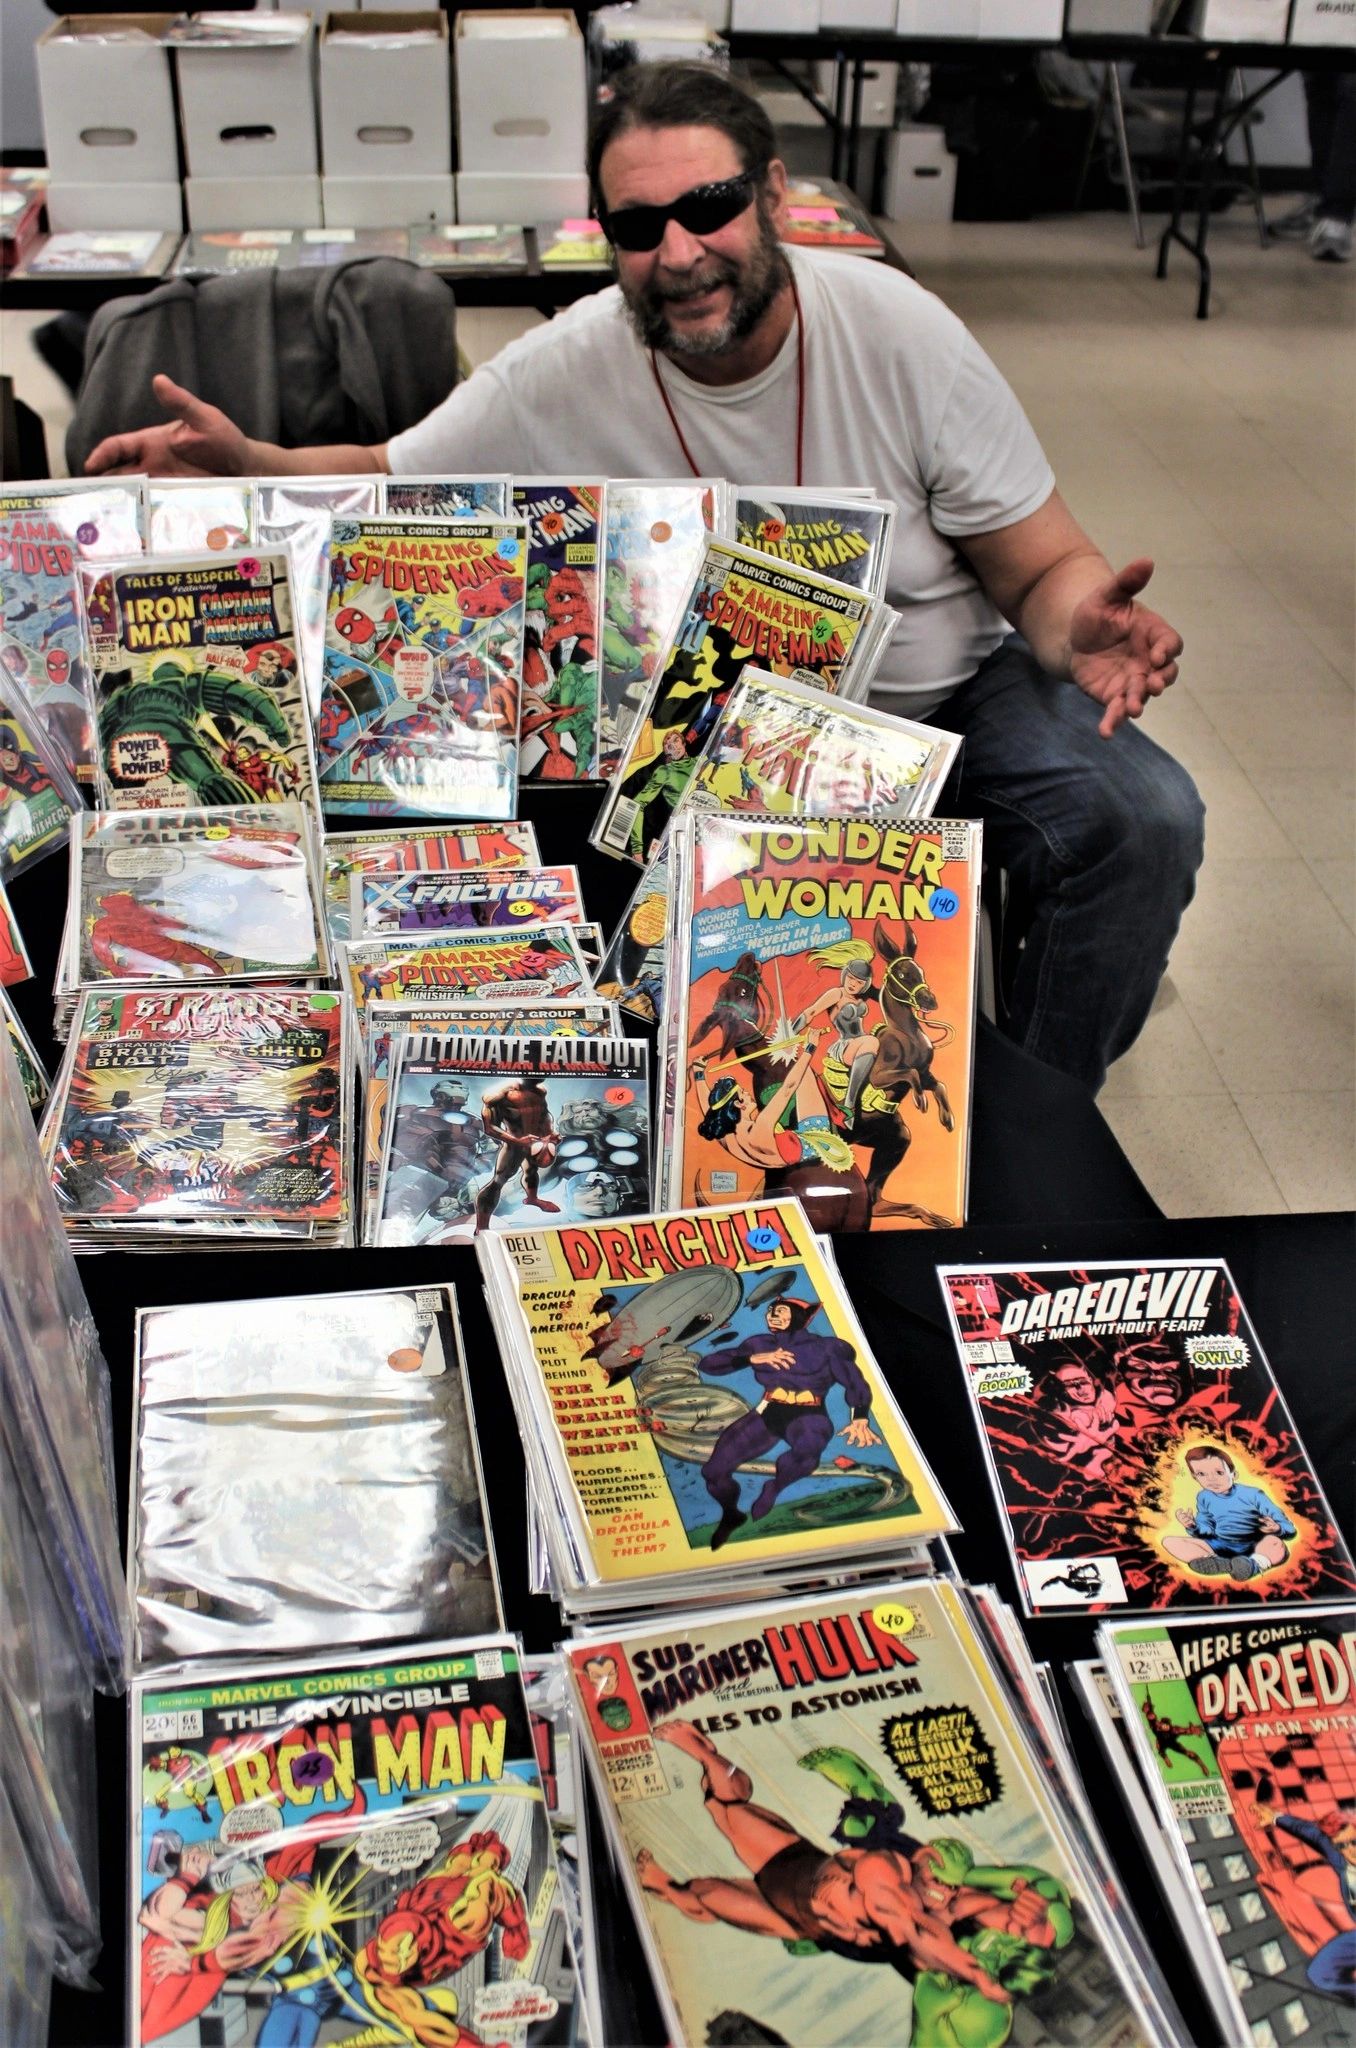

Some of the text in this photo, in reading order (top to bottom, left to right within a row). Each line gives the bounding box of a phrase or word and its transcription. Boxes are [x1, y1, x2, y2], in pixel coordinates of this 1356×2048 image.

[364, 526, 489, 536] MARVEL COMICS GROUP
[766, 525, 781, 535] 40
[386, 540, 483, 561] AMAZING
[502, 544, 515, 554] 20
[740, 530, 871, 569] PIDER-MAN
[125, 569, 248, 588] TALES OF SUSPENS
[346, 551, 516, 594] SPIDER-MAN
[733, 560, 849, 611] MARVEL COMICS GROUP
[124, 595, 196, 624] IRON
[743, 588, 825, 630] AMAZING
[128, 621, 192, 649] MAN
[704, 590, 847, 667] SPIDER-MAN
[119, 739, 161, 753] POWER
[121, 760, 165, 775] POWER!
[356, 828, 497, 844] MARVEL COMICS GROUP
[364, 874, 561, 911] X-FACTOR
[740, 877, 936, 921] WOMAN
[931, 896, 955, 913] 140
[698, 908, 739, 926] WONDER
[698, 919, 737, 934] WOMAN
[794, 926, 809, 938] IN
[811, 923, 821, 935] A
[389, 932, 545, 950] MAREL COMICS GROUP
[760, 940, 808, 958] MILLION
[420, 944, 531, 966] AMAZING
[380, 948, 575, 987] PIDER-MN
[411, 1010, 577, 1020] MARVEL COMICS GROUP
[99, 1047, 175, 1057] BRAIN
[403, 1036, 646, 1068] ULTIMATE FALLOUT
[506, 1236, 541, 1252] DELL
[557, 1207, 802, 1282] DRACULA
[753, 1233, 771, 1245] 10
[522, 1289, 576, 1301] DRACULA
[1001, 1269, 1217, 1335] DAREDEVIL
[532, 1299, 573, 1312] COMES
[549, 1313, 563, 1322] TO
[530, 1321, 590, 1334] AMERICA!
[1020, 1319, 1206, 1345] THE MAN WITHOUT FEAR!
[537, 1346, 558, 1356] THE
[1193, 1350, 1243, 1365] OWL!
[541, 1357, 567, 1368] PLOT
[544, 1369, 587, 1380] BEHIND
[985, 1371, 1013, 1379] BABY
[550, 1384, 593, 1396] THE
[978, 1376, 1027, 1394] BOOM!
[553, 1394, 626, 1410] DEATH
[557, 1407, 653, 1425] DEALING
[560, 1420, 668, 1441] WEATHER
[573, 1466, 637, 1476] FLOODS...
[582, 1493, 659, 1507] TORRENTIAL
[612, 1512, 643, 1523] CAN
[595, 1519, 670, 1537] DRACULA
[615, 1533, 656, 1546] STOP
[611, 1543, 666, 1558] THEM?
[882, 1614, 904, 1628] 40
[762, 1609, 920, 1692] HULK
[1181, 1624, 1318, 1678] HERE COMES...
[632, 1642, 706, 1682] SUB-
[211, 1683, 298, 1705] MARVEL
[304, 1674, 387, 1694] COMICS
[394, 1663, 467, 1683] GROUP
[640, 1639, 770, 1722] MARINER
[1198, 1632, 1356, 1720] DARED
[712, 1679, 752, 1695] and
[733, 1683, 781, 1698] INCREDIBLE
[219, 1684, 470, 1730] THE VINCIBLE
[744, 1677, 923, 1726] TO ASTONISH
[182, 1714, 196, 1725] 66
[891, 1712, 967, 1739] AT LAST!!
[892, 1737, 916, 1749] THE
[918, 1730, 960, 1745] SECRET
[1208, 1722, 1248, 1741] THE
[1255, 1720, 1302, 1738] MAN
[601, 1739, 653, 1759] MARVEL
[895, 1737, 977, 1764] THE HULK
[208, 1704, 507, 1814] IRON MAN
[905, 1753, 989, 1779] REVEALED FOR
[923, 1768, 979, 1789] ALL THE
[928, 1778, 983, 1800] WORLD
[1168, 1783, 1227, 1800] MARVEL
[932, 1787, 992, 1811] TO SEE!
